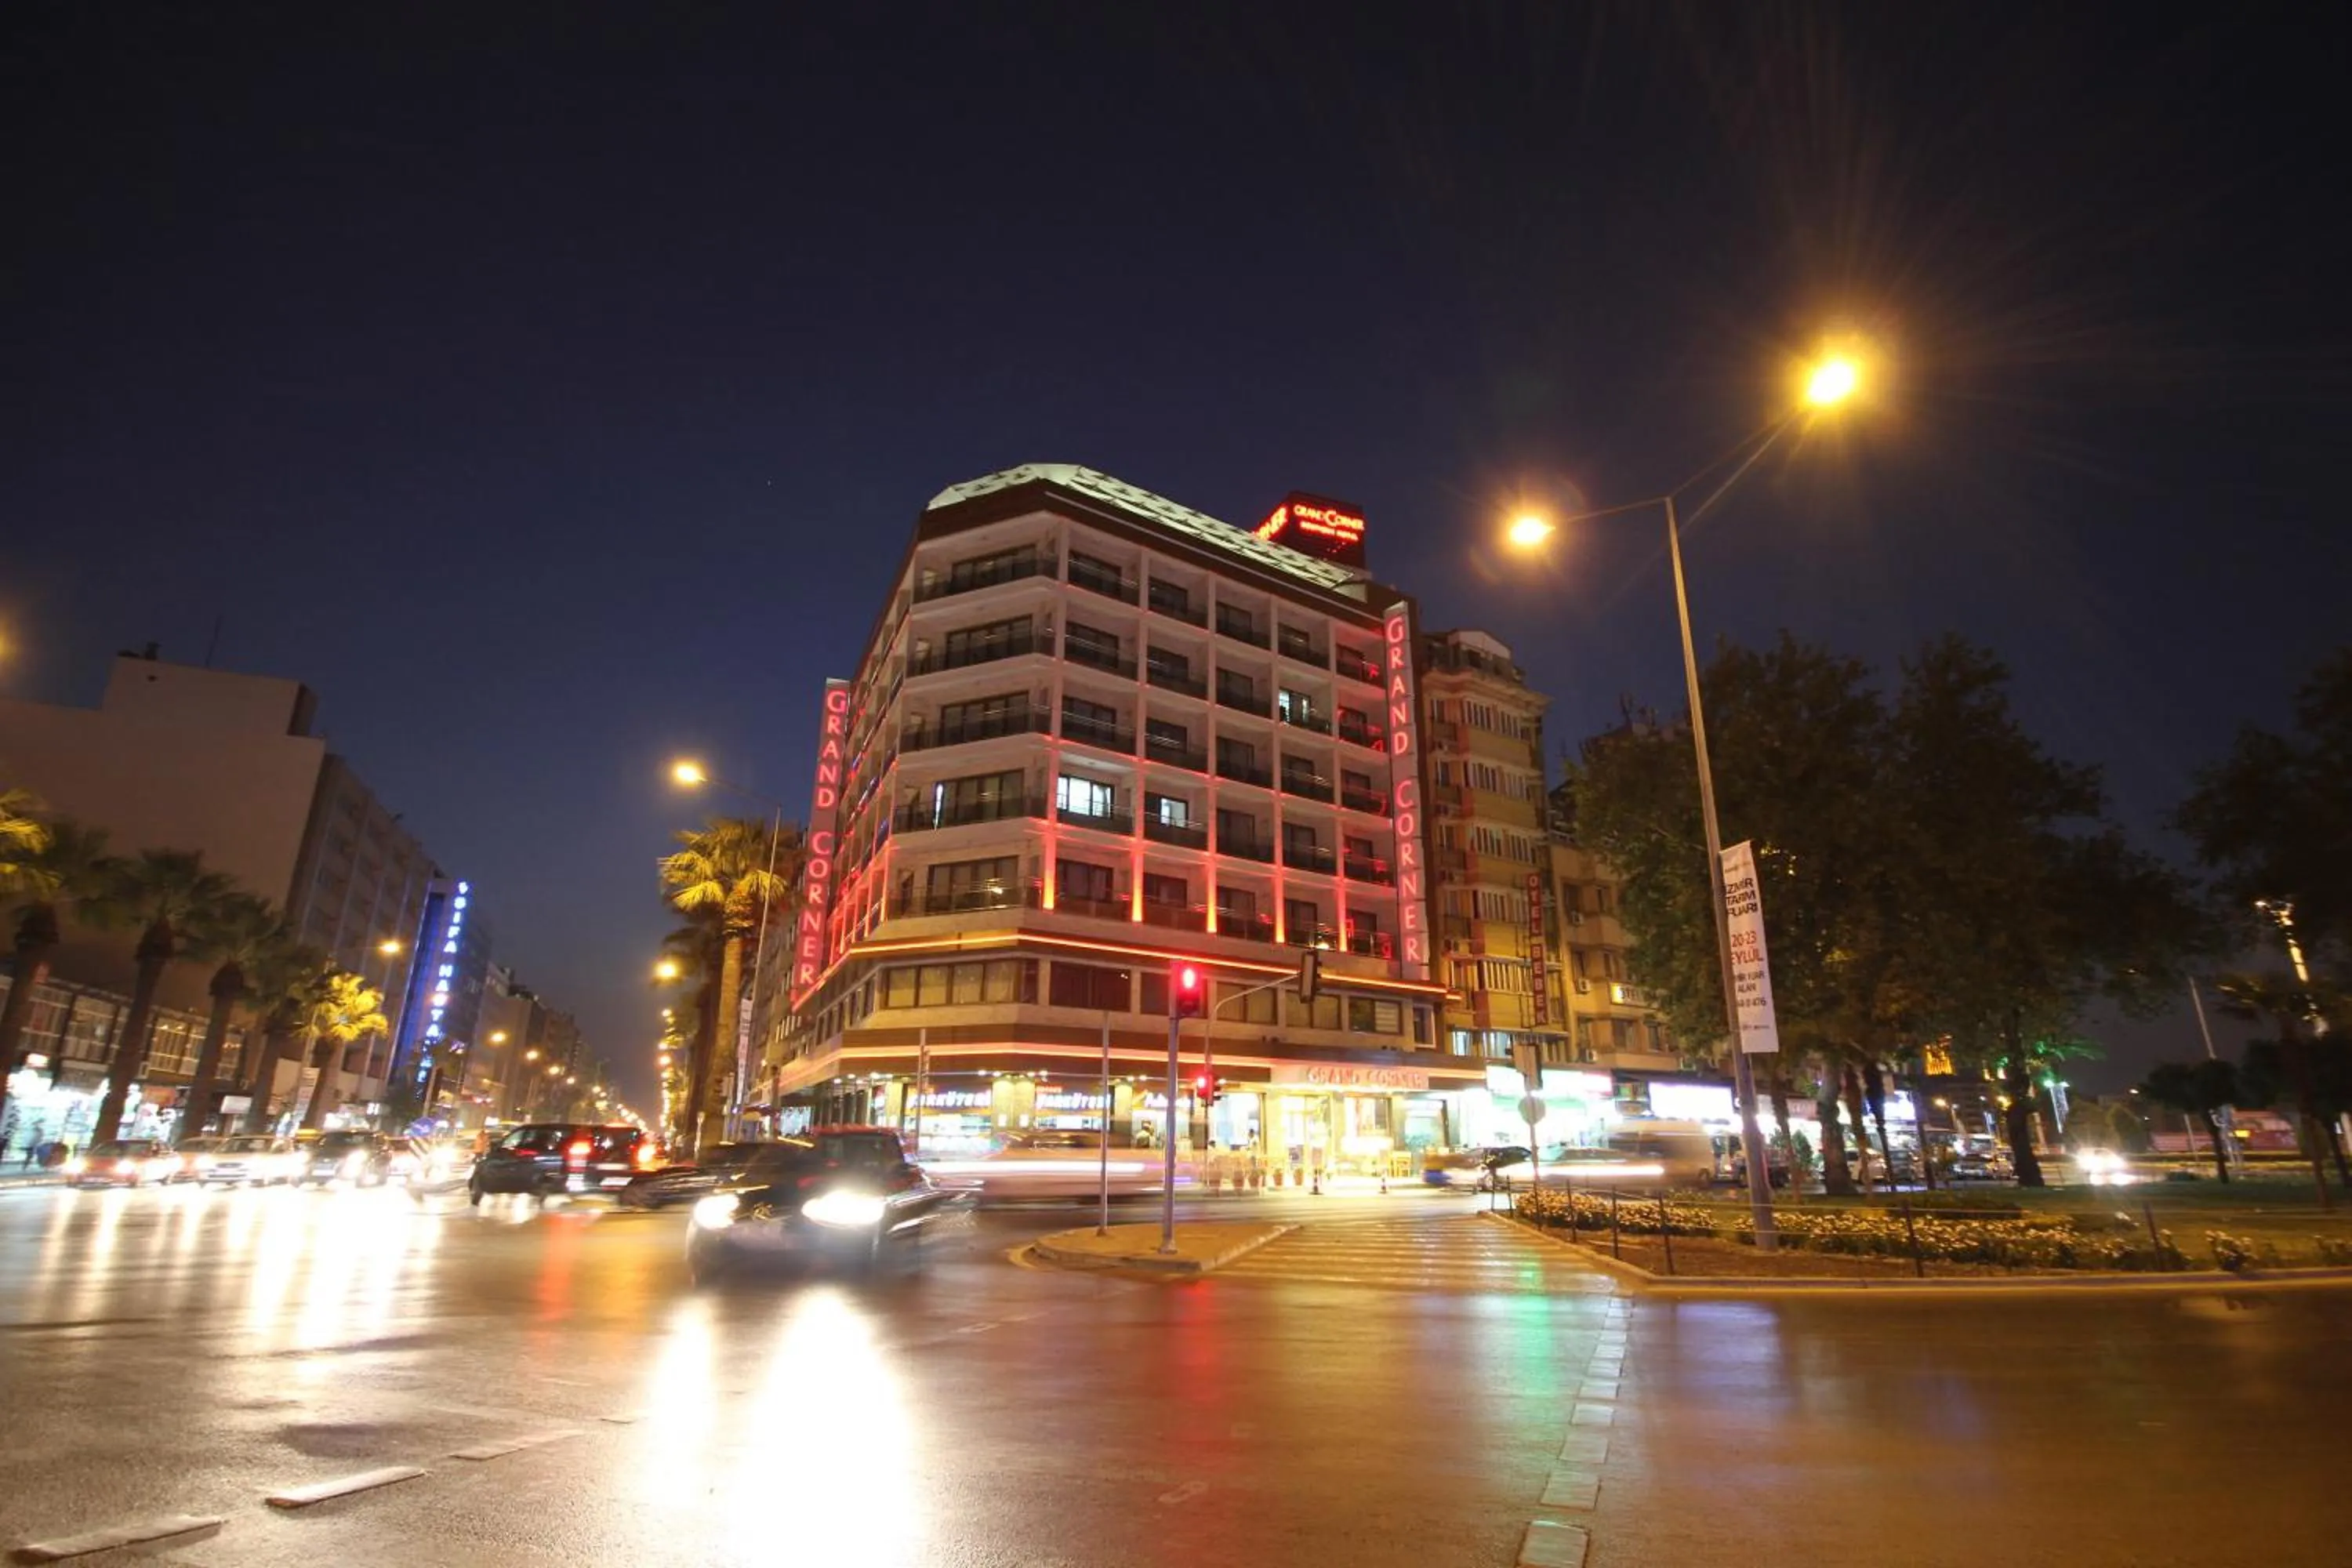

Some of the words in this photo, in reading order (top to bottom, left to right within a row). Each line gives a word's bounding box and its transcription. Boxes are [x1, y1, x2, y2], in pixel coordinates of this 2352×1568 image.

[1387, 616, 1408, 755] GRAND
[817, 690, 848, 809] GRAND
[799, 831, 833, 985] CORNER
[1396, 780, 1421, 963] CORNER
[1529, 875, 1541, 934] OTEL
[1533, 946, 1547, 1024] BEBEK
[1307, 1065, 1360, 1084] GRAND
[1367, 1069, 1423, 1090] CORNER
